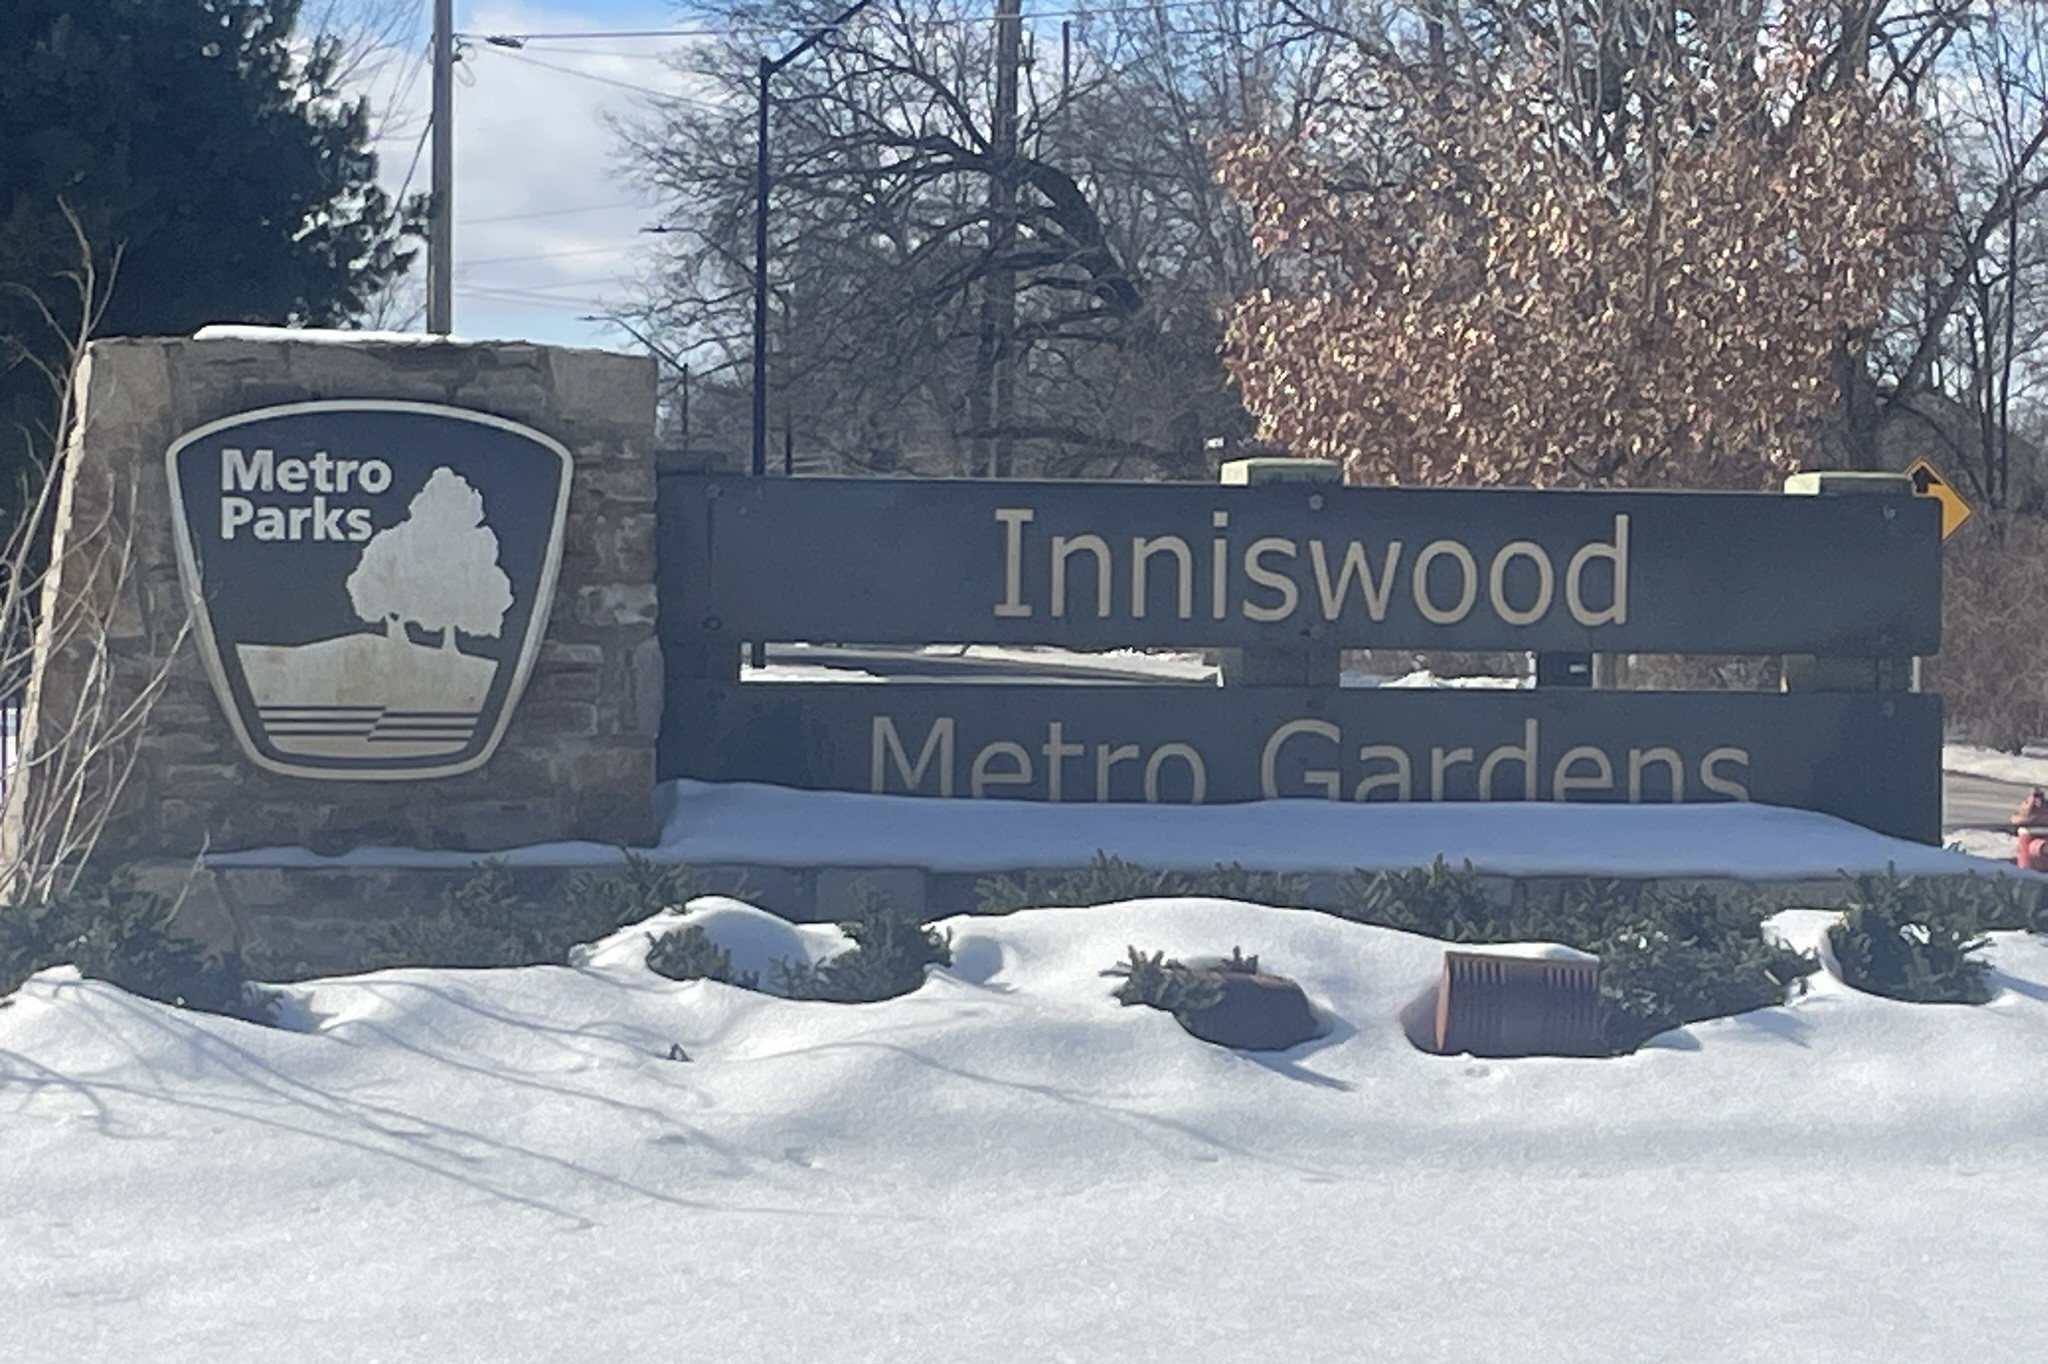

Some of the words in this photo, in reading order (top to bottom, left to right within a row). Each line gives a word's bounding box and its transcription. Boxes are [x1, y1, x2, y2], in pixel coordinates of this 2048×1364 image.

[221, 449, 392, 493] Metro
[220, 496, 373, 541] Parks
[994, 508, 1630, 626] Inniswood
[871, 716, 1207, 802] Metro
[1261, 718, 1752, 804] Gardens
